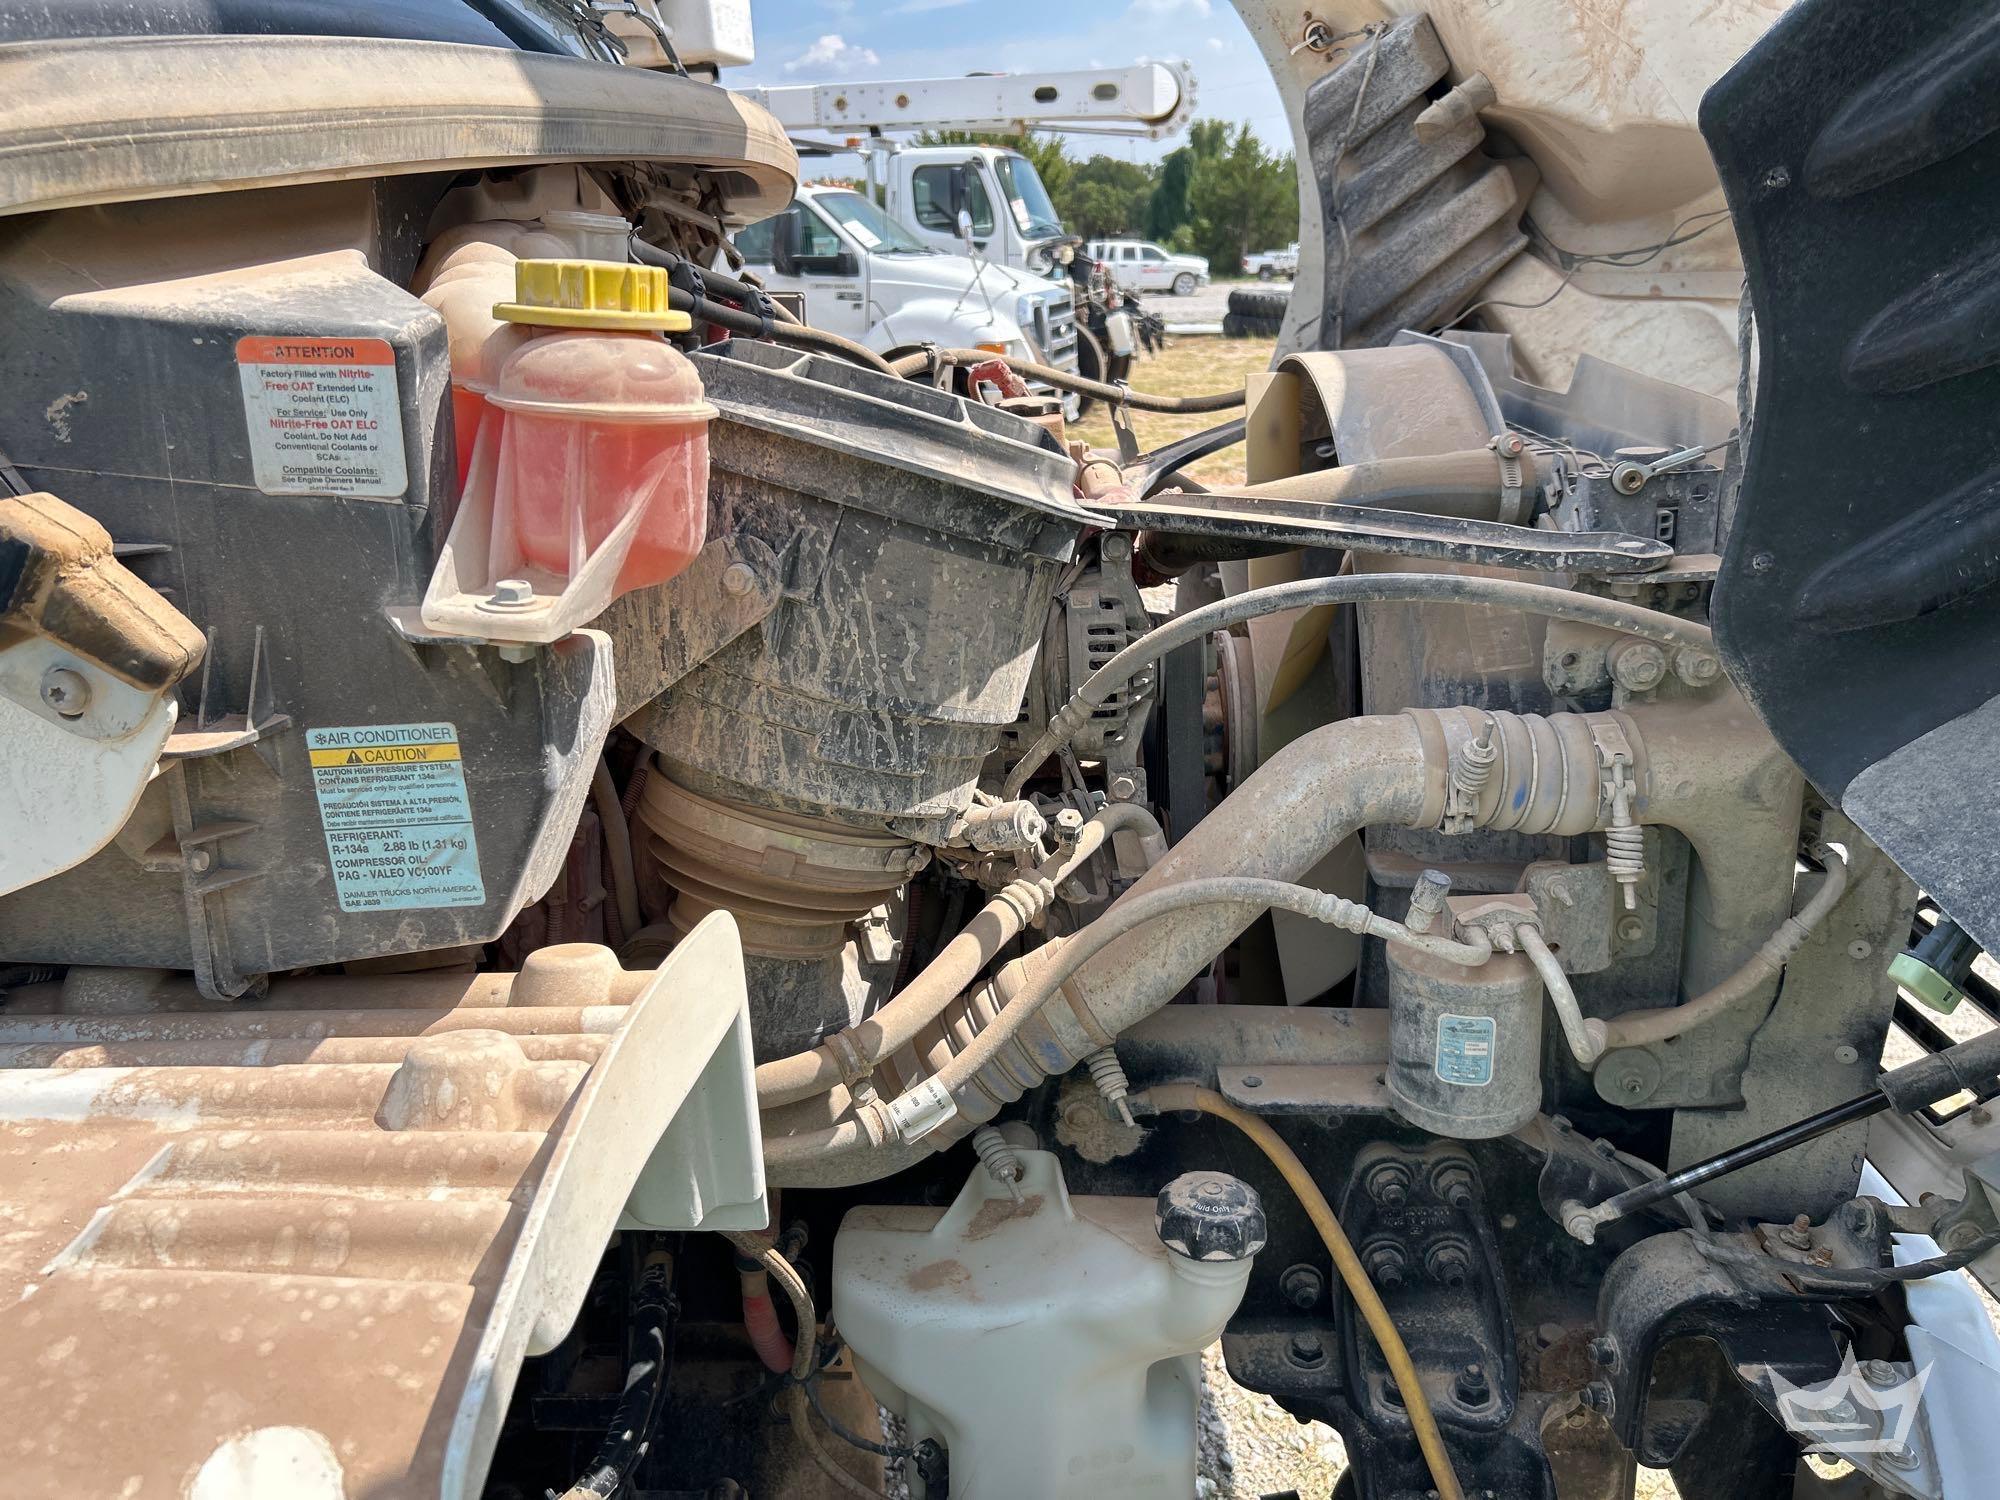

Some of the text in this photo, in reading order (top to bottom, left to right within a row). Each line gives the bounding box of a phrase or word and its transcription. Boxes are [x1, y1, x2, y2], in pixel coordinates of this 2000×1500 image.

[275, 346, 355, 358] ATTENTION
[261, 370, 292, 379] Factory
[339, 370, 374, 379] Nitrite-
[265, 382, 289, 390] Free
[292, 382, 315, 391] OAT
[292, 395, 350, 404] Coolant (ELC)
[277, 408, 290, 416] For
[293, 409, 327, 417] Service:
[349, 410, 368, 418] Only
[270, 419, 377, 430] Nitrite-Free OAT ELC
[331, 443, 367, 451] Coolants
[283, 466, 378, 476] Compatible Coolants:
[328, 727, 451, 744] AIR CONDITIONER
[364, 748, 427, 762] CAUTION
[354, 767, 374, 775] HIGH
[376, 765, 417, 773] PRESSURE
[319, 776, 359, 785] CONTAINS
[361, 774, 415, 783] REFRIGERANT
[374, 784, 387, 792] only
[398, 783, 424, 791] qualified
[324, 801, 369, 809] PRECAUCIÓN
[370, 799, 400, 807] SISTEMA
[325, 809, 361, 818] CONTIENE
[330, 830, 403, 842] REFRIGERANT:
[332, 839, 467, 854] R-134a 2.88 lb (1.31 kg)
[336, 855, 428, 868] COMPRESSOR OIL:
[338, 870, 360, 880] PAG
[371, 868, 405, 878] VALEO
[409, 866, 452, 876] VC100YF
[344, 891, 378, 899] DAIMLER
[380, 888, 412, 896] TRUCKS
[442, 885, 477, 893] AMERICA
[1212, 1205, 1230, 1213] Only
